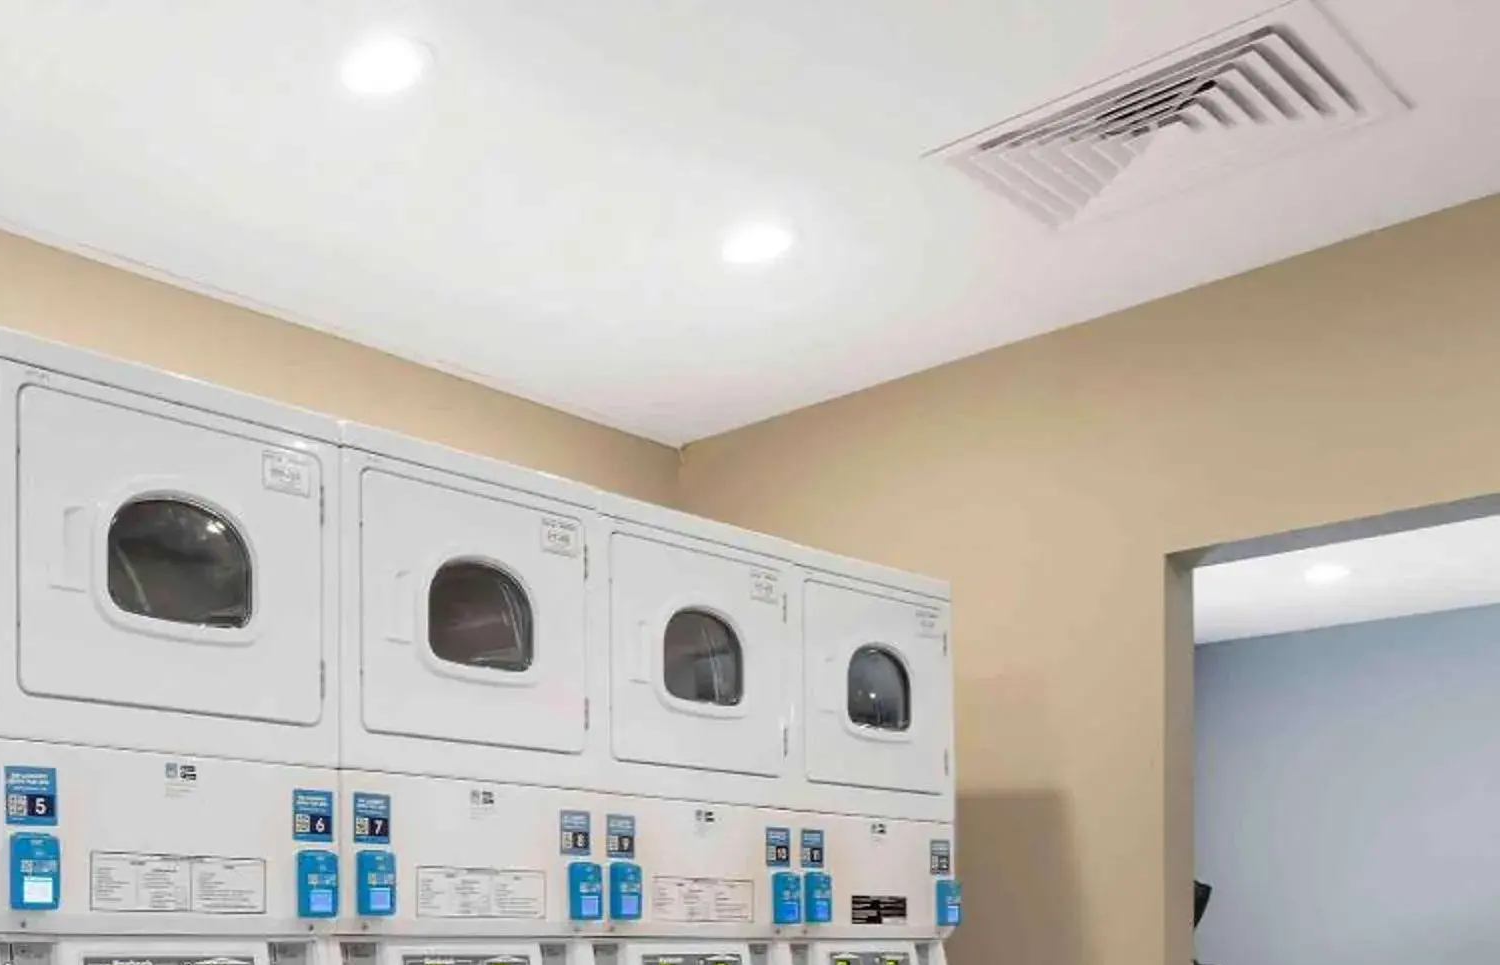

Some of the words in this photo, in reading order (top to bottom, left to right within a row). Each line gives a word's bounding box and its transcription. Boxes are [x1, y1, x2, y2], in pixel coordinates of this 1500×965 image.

[35, 798, 48, 815] 5
[315, 818, 326, 833] 6
[373, 819, 384, 835] 7
